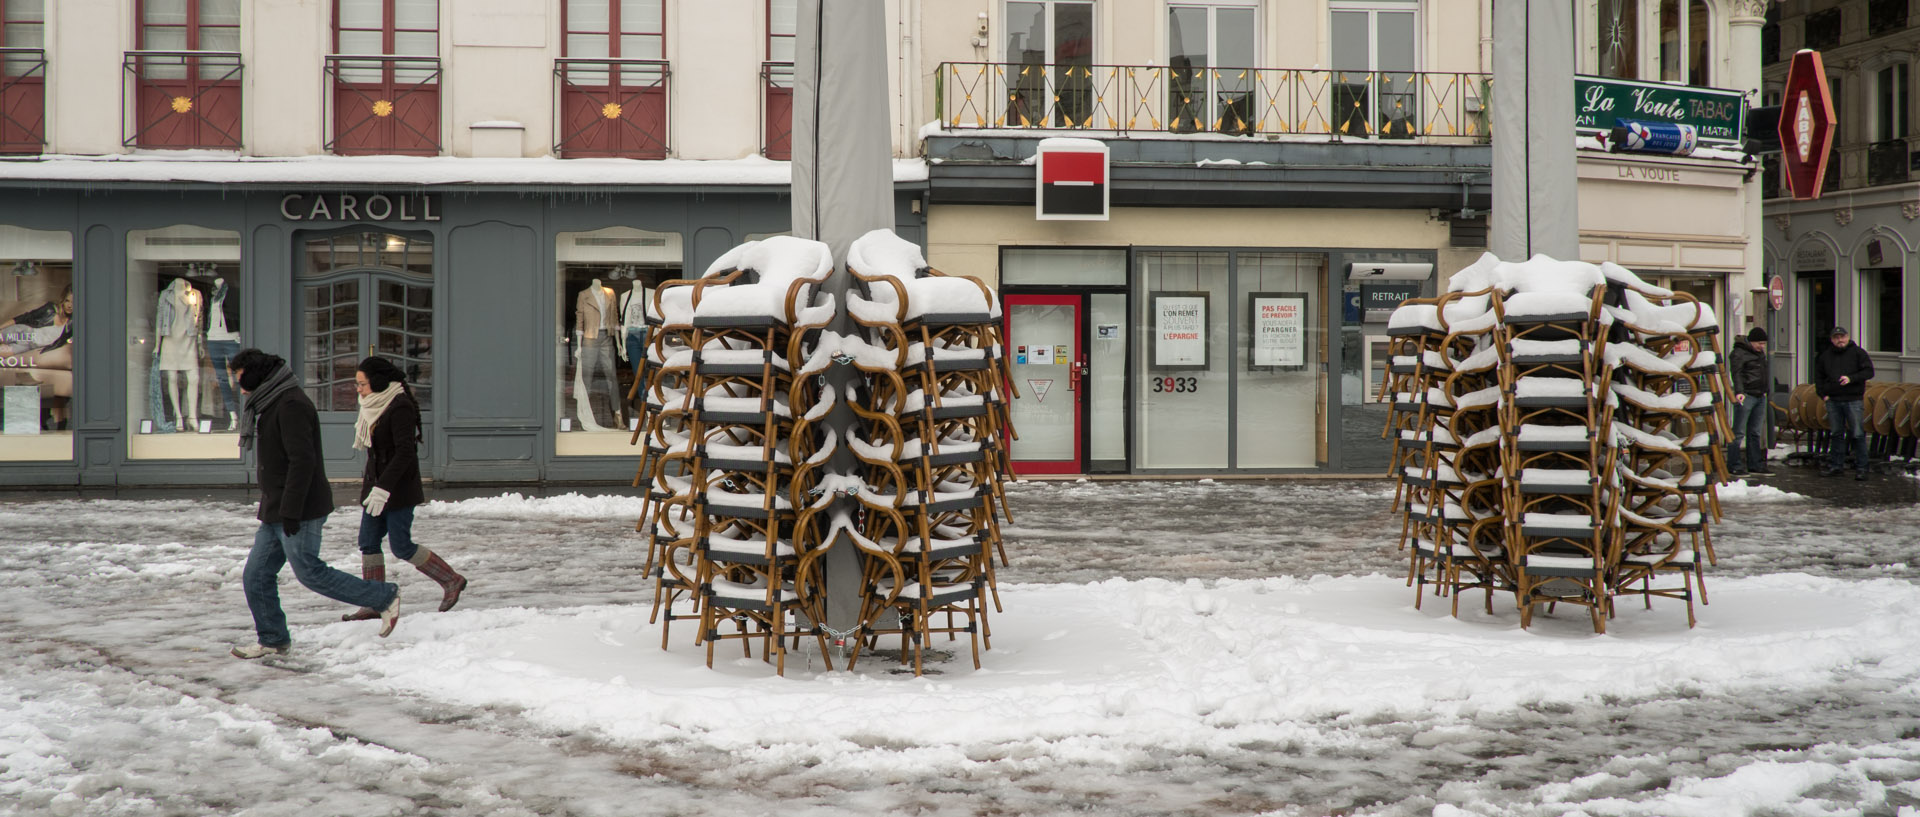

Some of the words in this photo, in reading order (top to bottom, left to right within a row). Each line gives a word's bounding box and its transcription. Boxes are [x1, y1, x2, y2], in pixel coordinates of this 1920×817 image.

[1582, 85, 1616, 113] La
[1630, 88, 1686, 121] Voute
[1689, 98, 1734, 121] TABAC
[1702, 125, 1733, 137] MATIN
[1798, 96, 1810, 156] TABAC
[1617, 165, 1635, 179] LA
[1639, 167, 1680, 182] VOUTE
[280, 194, 441, 221] CAROLL
[1372, 292, 1409, 301] RETRAIT
[1163, 316, 1198, 325] SOUVENT
[6, 332, 37, 342] MILLER
[1153, 377, 1197, 393] 3933
